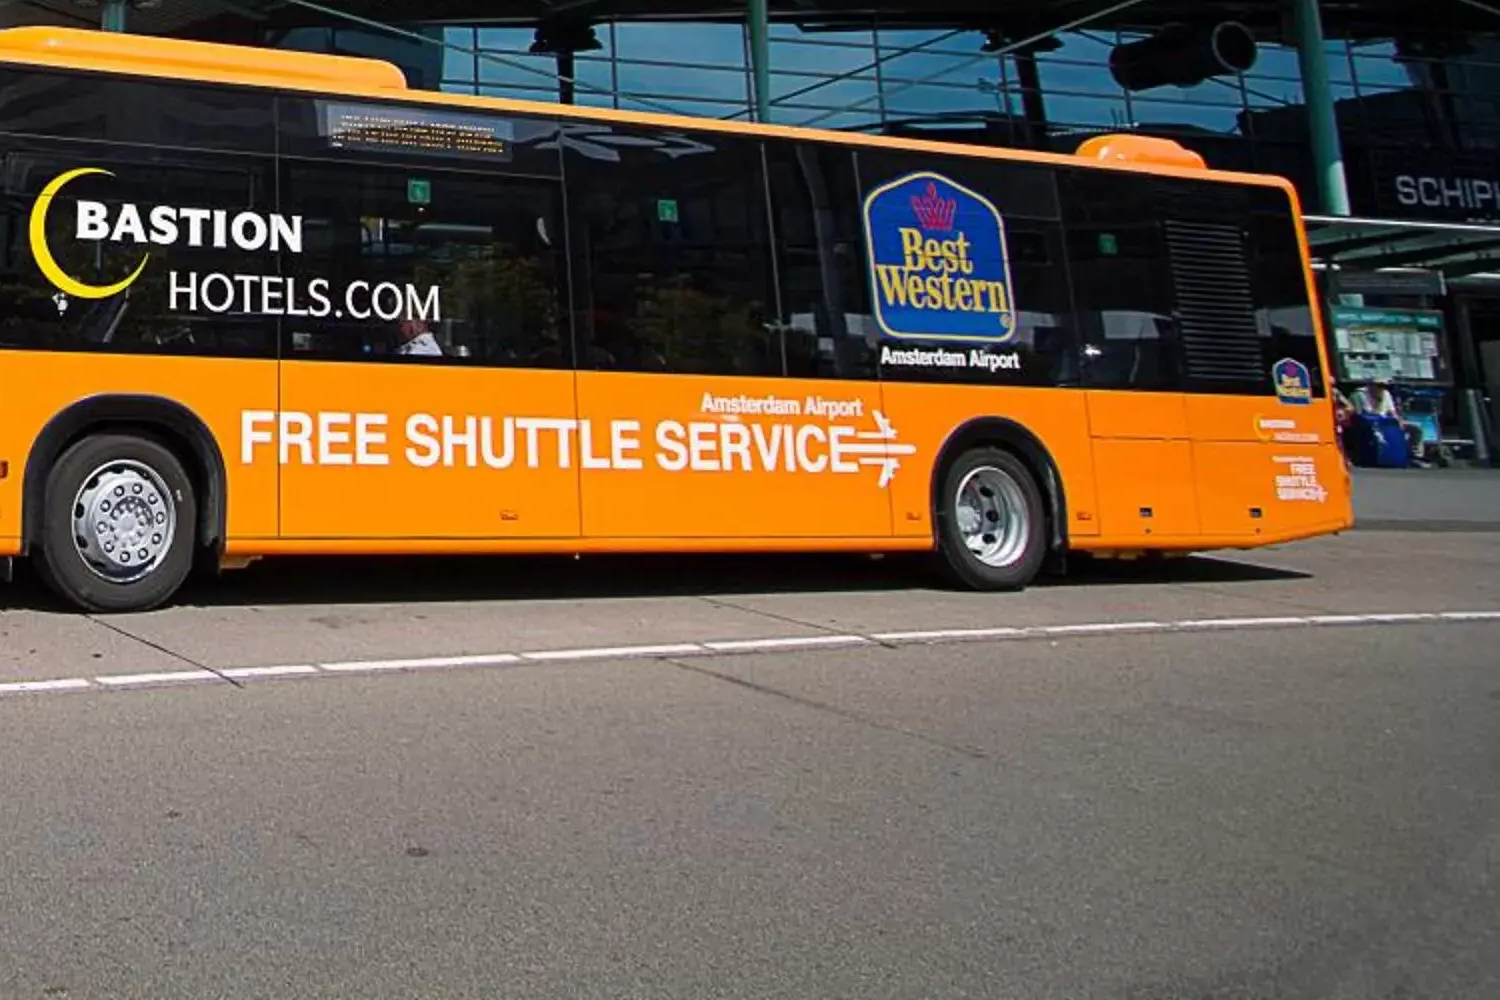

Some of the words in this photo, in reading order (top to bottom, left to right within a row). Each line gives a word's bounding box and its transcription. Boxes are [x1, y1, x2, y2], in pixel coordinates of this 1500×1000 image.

[75, 200, 303, 253] BASTION
[898, 227, 974, 275] Best
[168, 270, 441, 323] HOTELS.COM
[875, 264, 1010, 313] Western
[881, 346, 966, 368] Amsterdam
[969, 349, 1021, 372] Airport
[700, 392, 801, 416] Amsterdam
[804, 396, 863, 420] Airport
[241, 409, 390, 465] FREE
[404, 413, 644, 470] SHUTTLE
[655, 419, 859, 474] SERVICE
